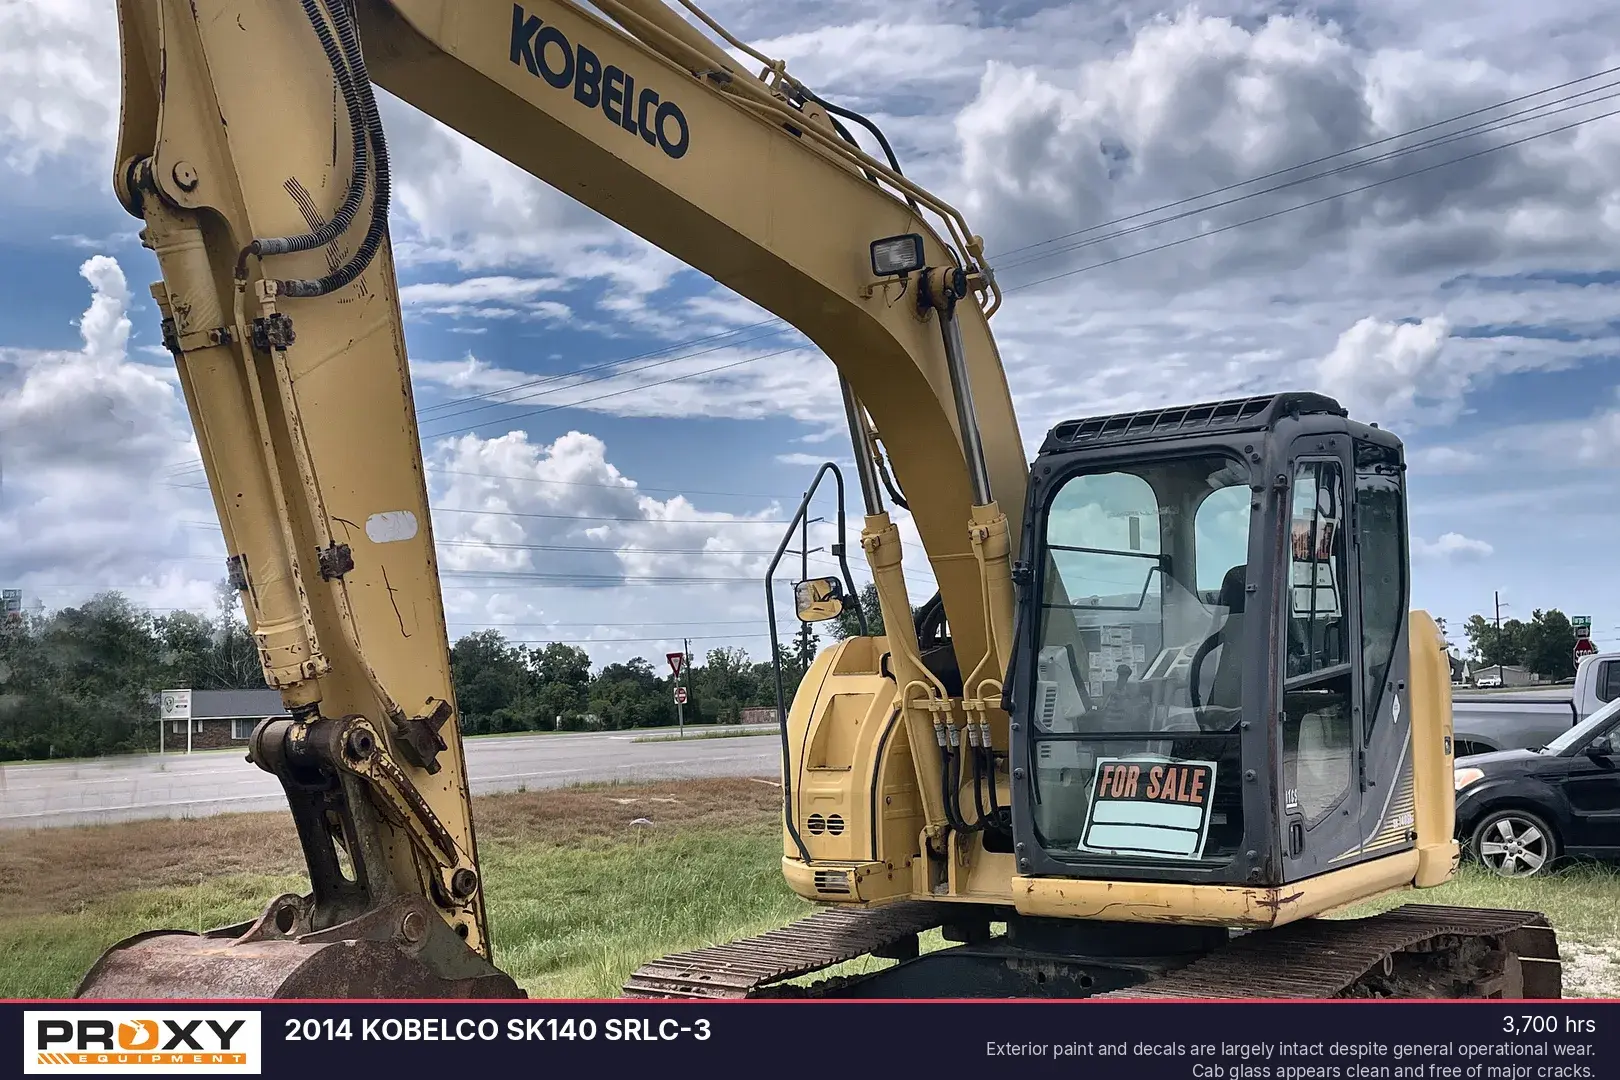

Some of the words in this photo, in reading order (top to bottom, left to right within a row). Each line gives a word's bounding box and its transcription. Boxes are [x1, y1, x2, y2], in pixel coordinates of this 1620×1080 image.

[510, 3, 689, 159] KOBELCO
[1099, 765, 1140, 798] FOR
[1146, 765, 1206, 803] SALE
